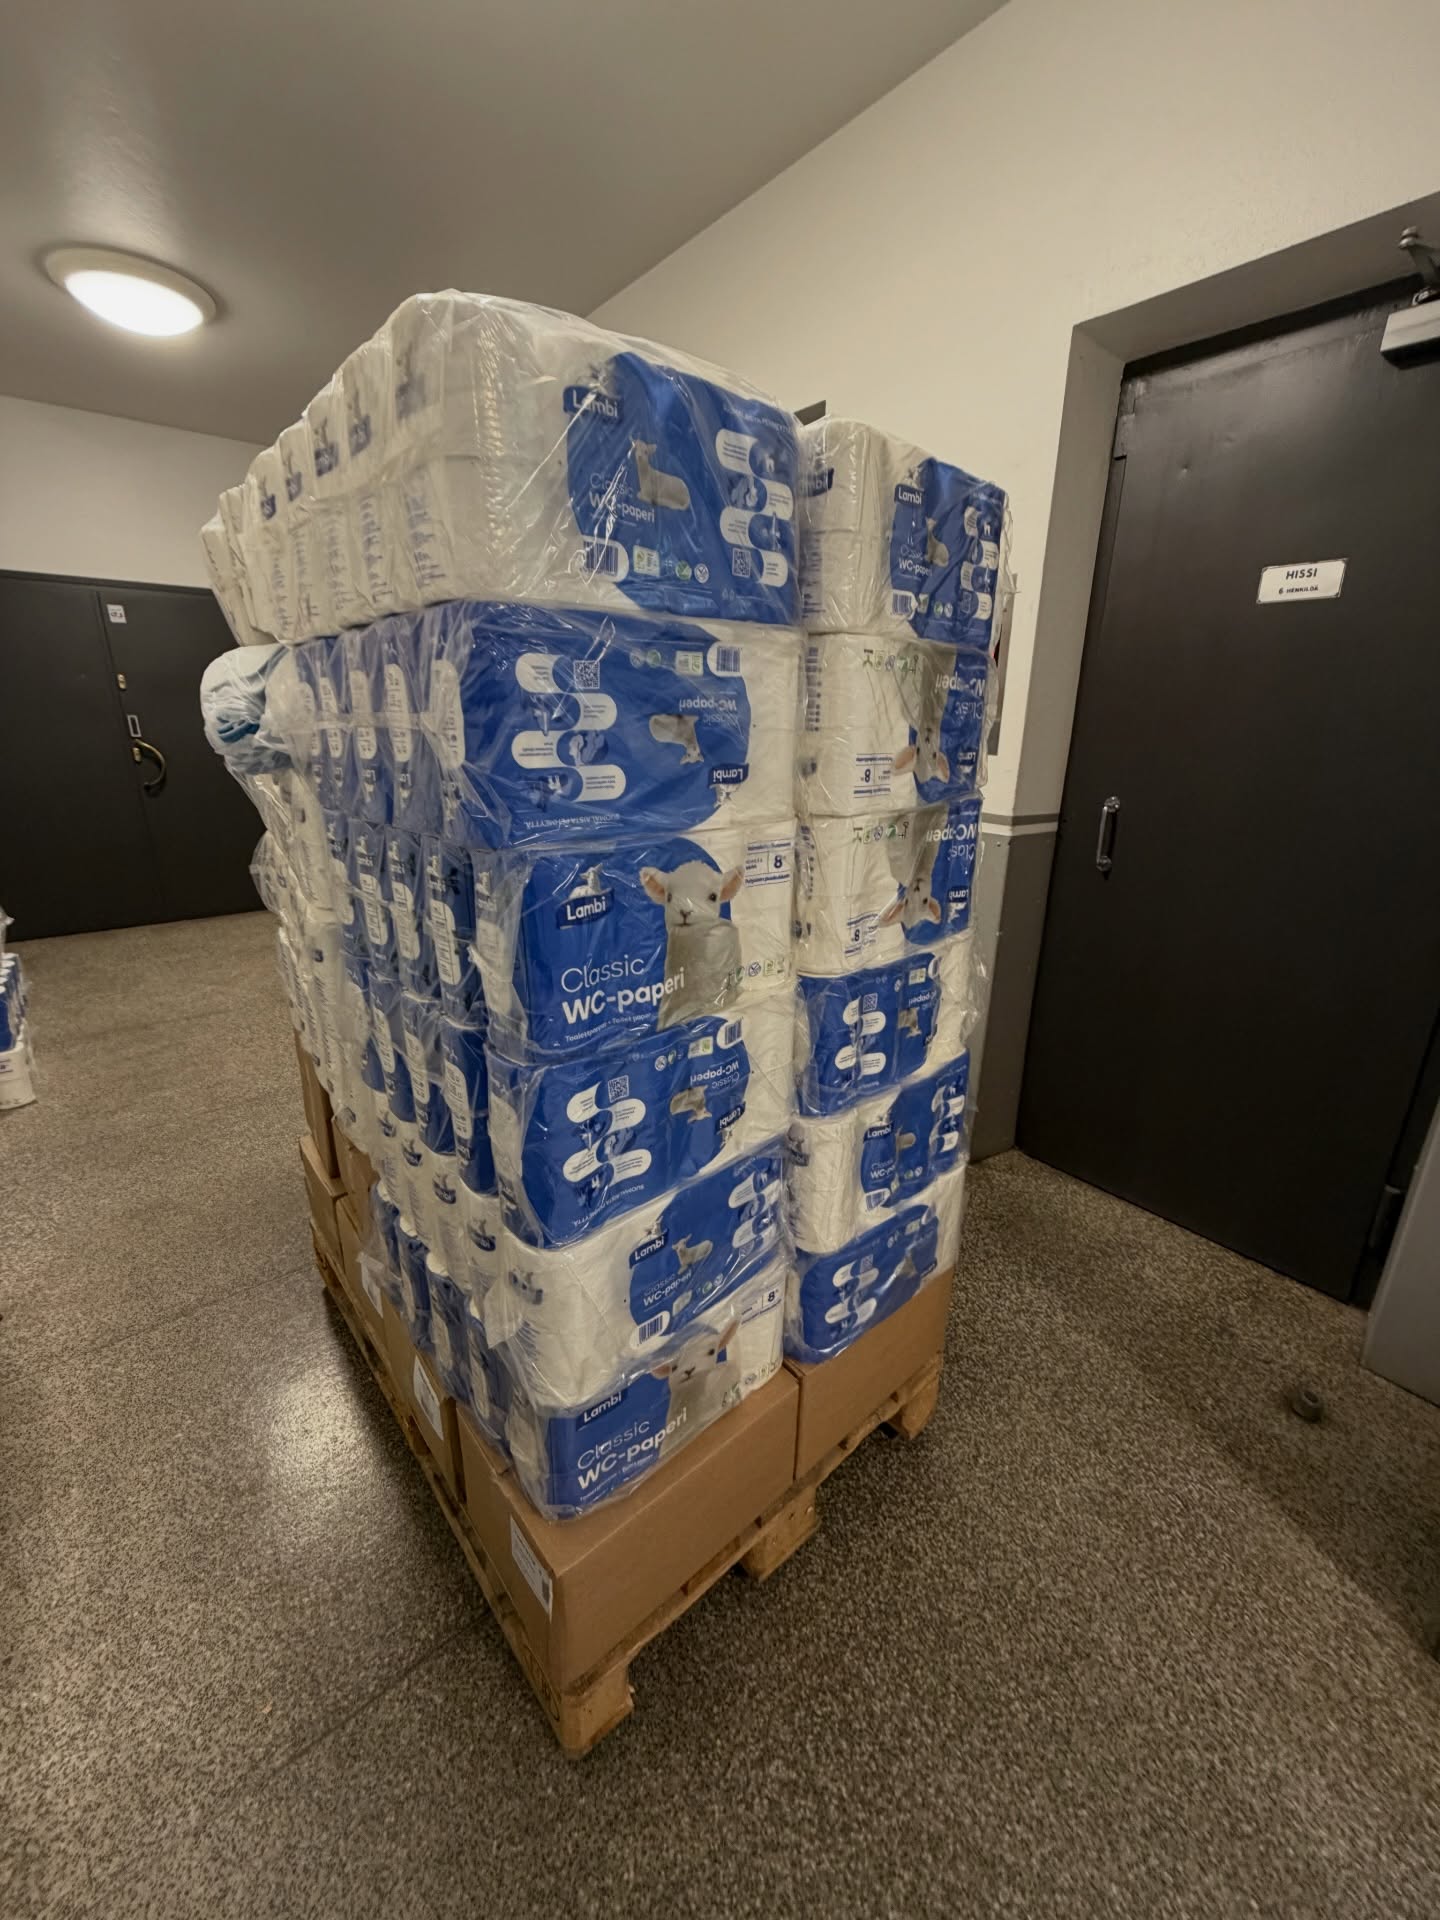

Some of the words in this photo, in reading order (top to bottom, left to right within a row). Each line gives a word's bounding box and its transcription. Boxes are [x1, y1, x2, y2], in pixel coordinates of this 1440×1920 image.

[898, 486, 922, 505] Lambi
[1286, 567, 1318, 580] HISSI
[679, 696, 738, 712] WC-paperi
[712, 768, 743, 783] Lambi
[566, 895, 607, 922] Lambi
[560, 954, 646, 993] Classic
[561, 966, 685, 1026] WC-paperi
[690, 1060, 740, 1084] WC-paperi
[718, 1107, 742, 1130] Lambi
[867, 1124, 892, 1138] Lambi
[634, 1236, 665, 1261] Lambi
[642, 1269, 692, 1307] WC-paperi
[583, 1392, 622, 1424] Lambi
[577, 1420, 650, 1470] Classic
[577, 1407, 688, 1490] WC-paperi
